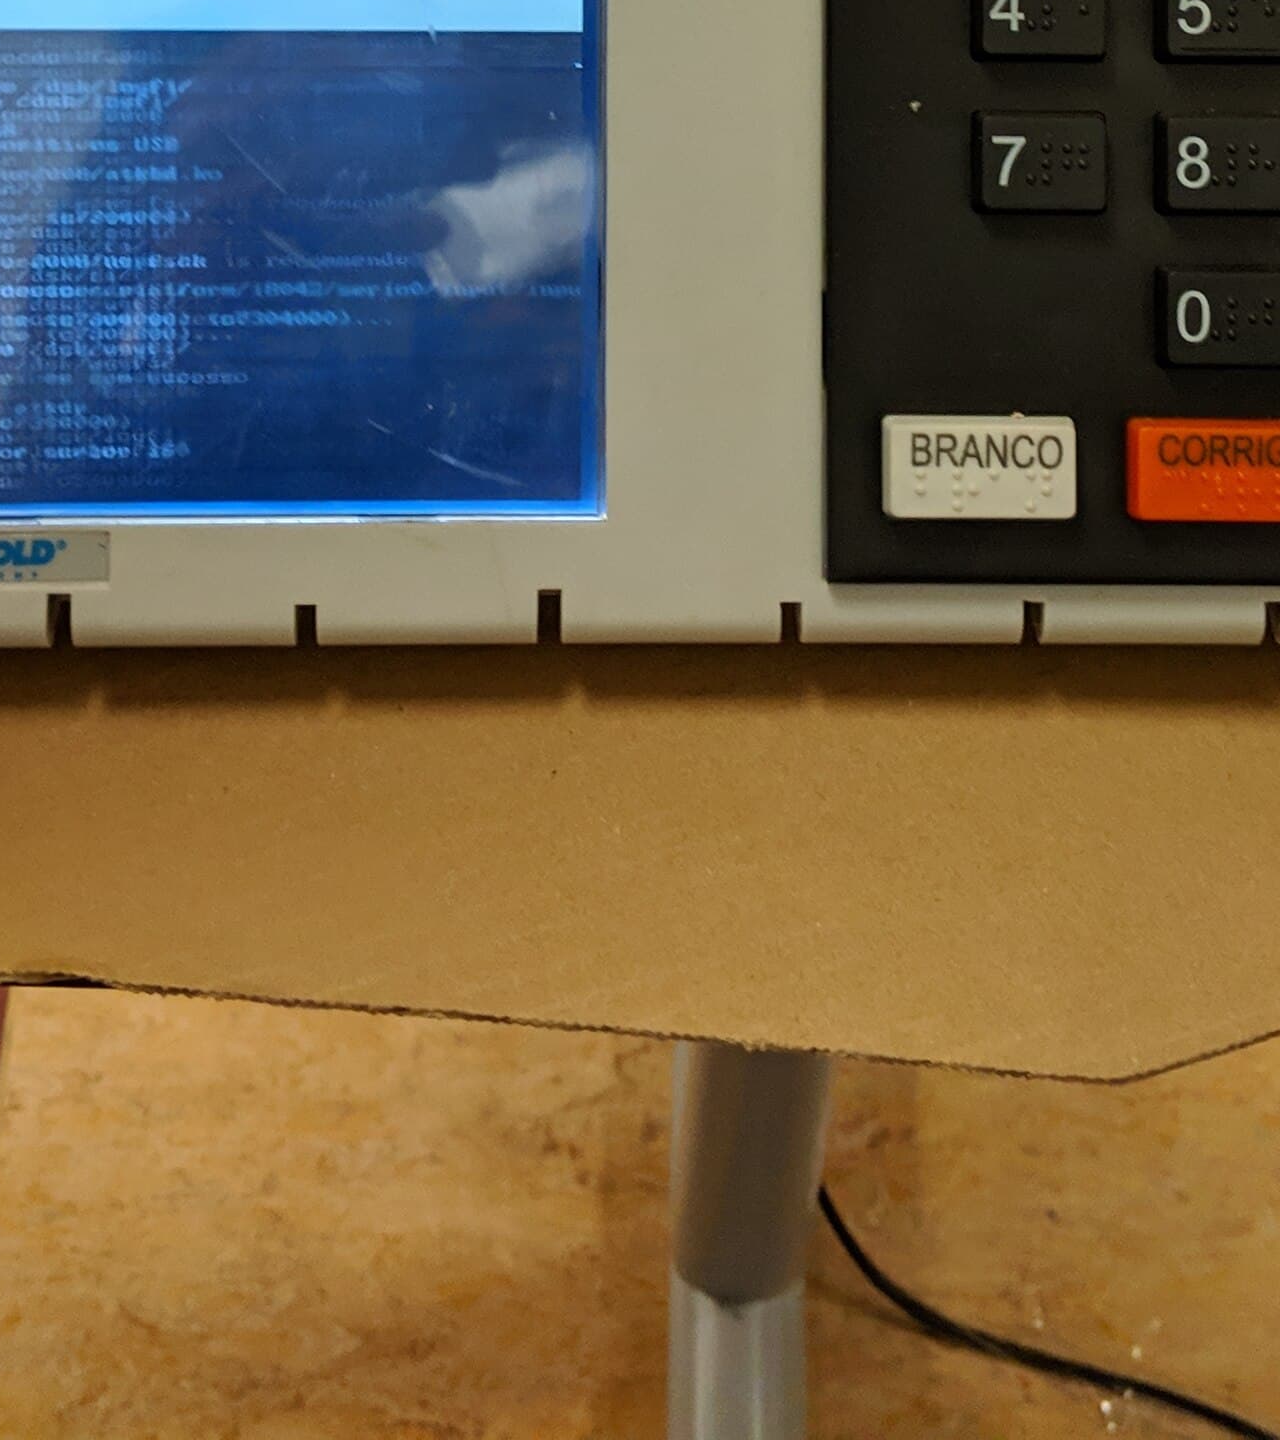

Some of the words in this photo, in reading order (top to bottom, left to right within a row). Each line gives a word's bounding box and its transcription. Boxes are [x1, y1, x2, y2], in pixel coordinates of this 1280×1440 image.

[991, 136, 1026, 187] 7
[1176, 136, 1211, 189] 8
[1176, 290, 1211, 343] 0
[912, 433, 1063, 469] BRANCO
